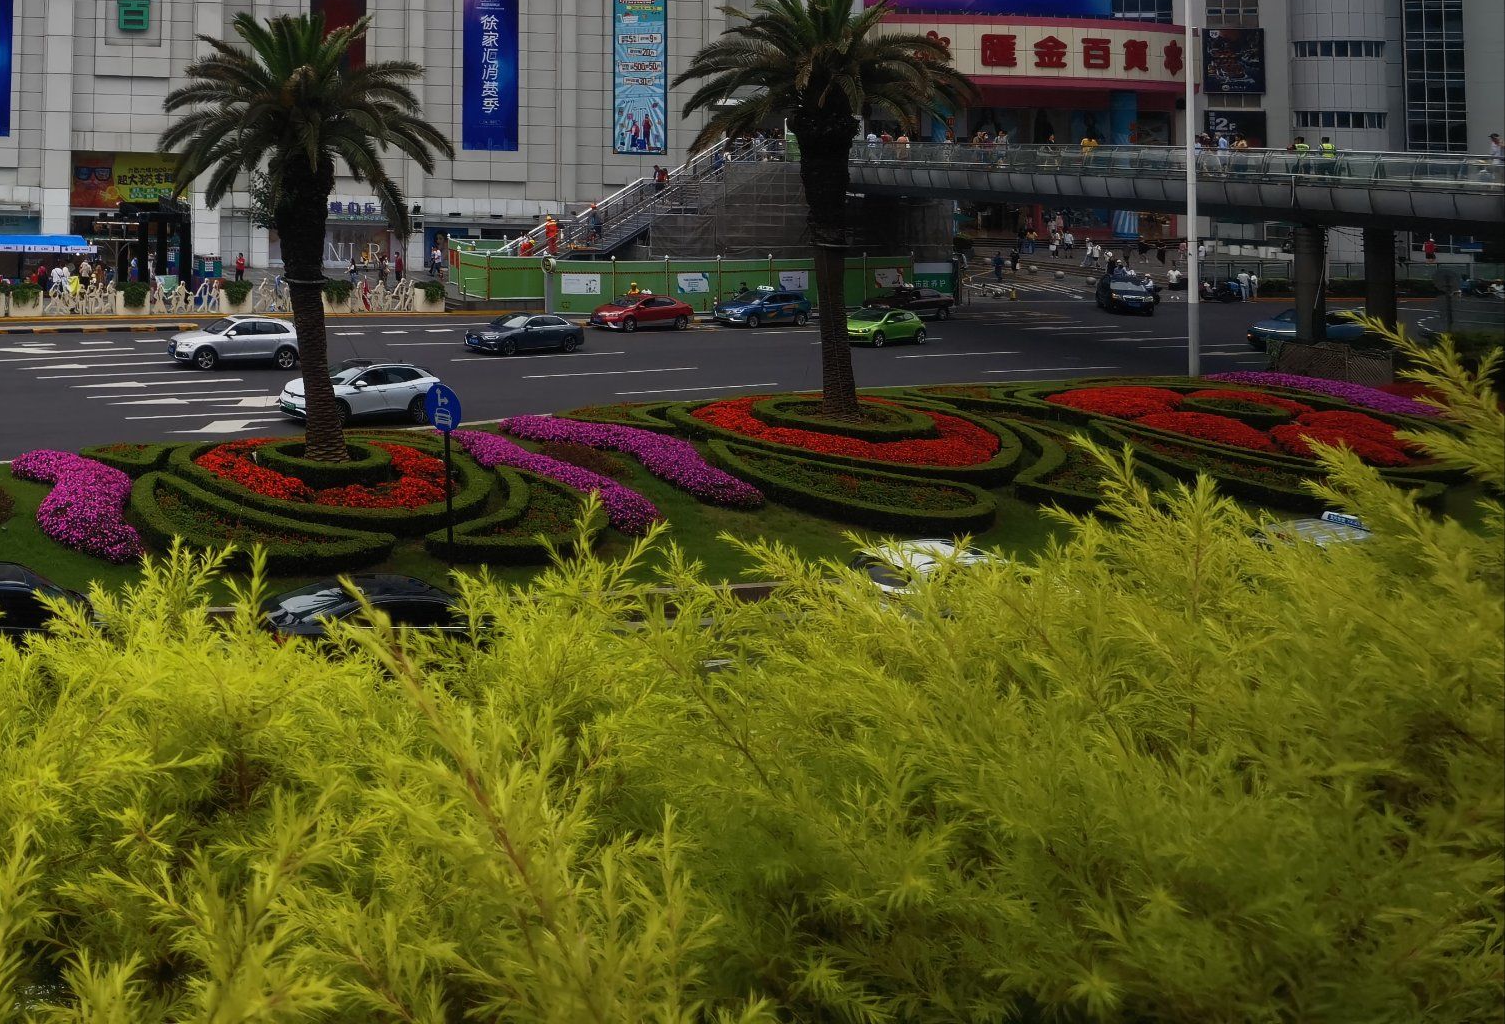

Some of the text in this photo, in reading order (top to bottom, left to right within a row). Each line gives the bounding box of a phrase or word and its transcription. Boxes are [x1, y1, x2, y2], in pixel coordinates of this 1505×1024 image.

[480, 14, 500, 114] 徐家汇消费季
[981, 34, 1149, 72] 匯金百貨
